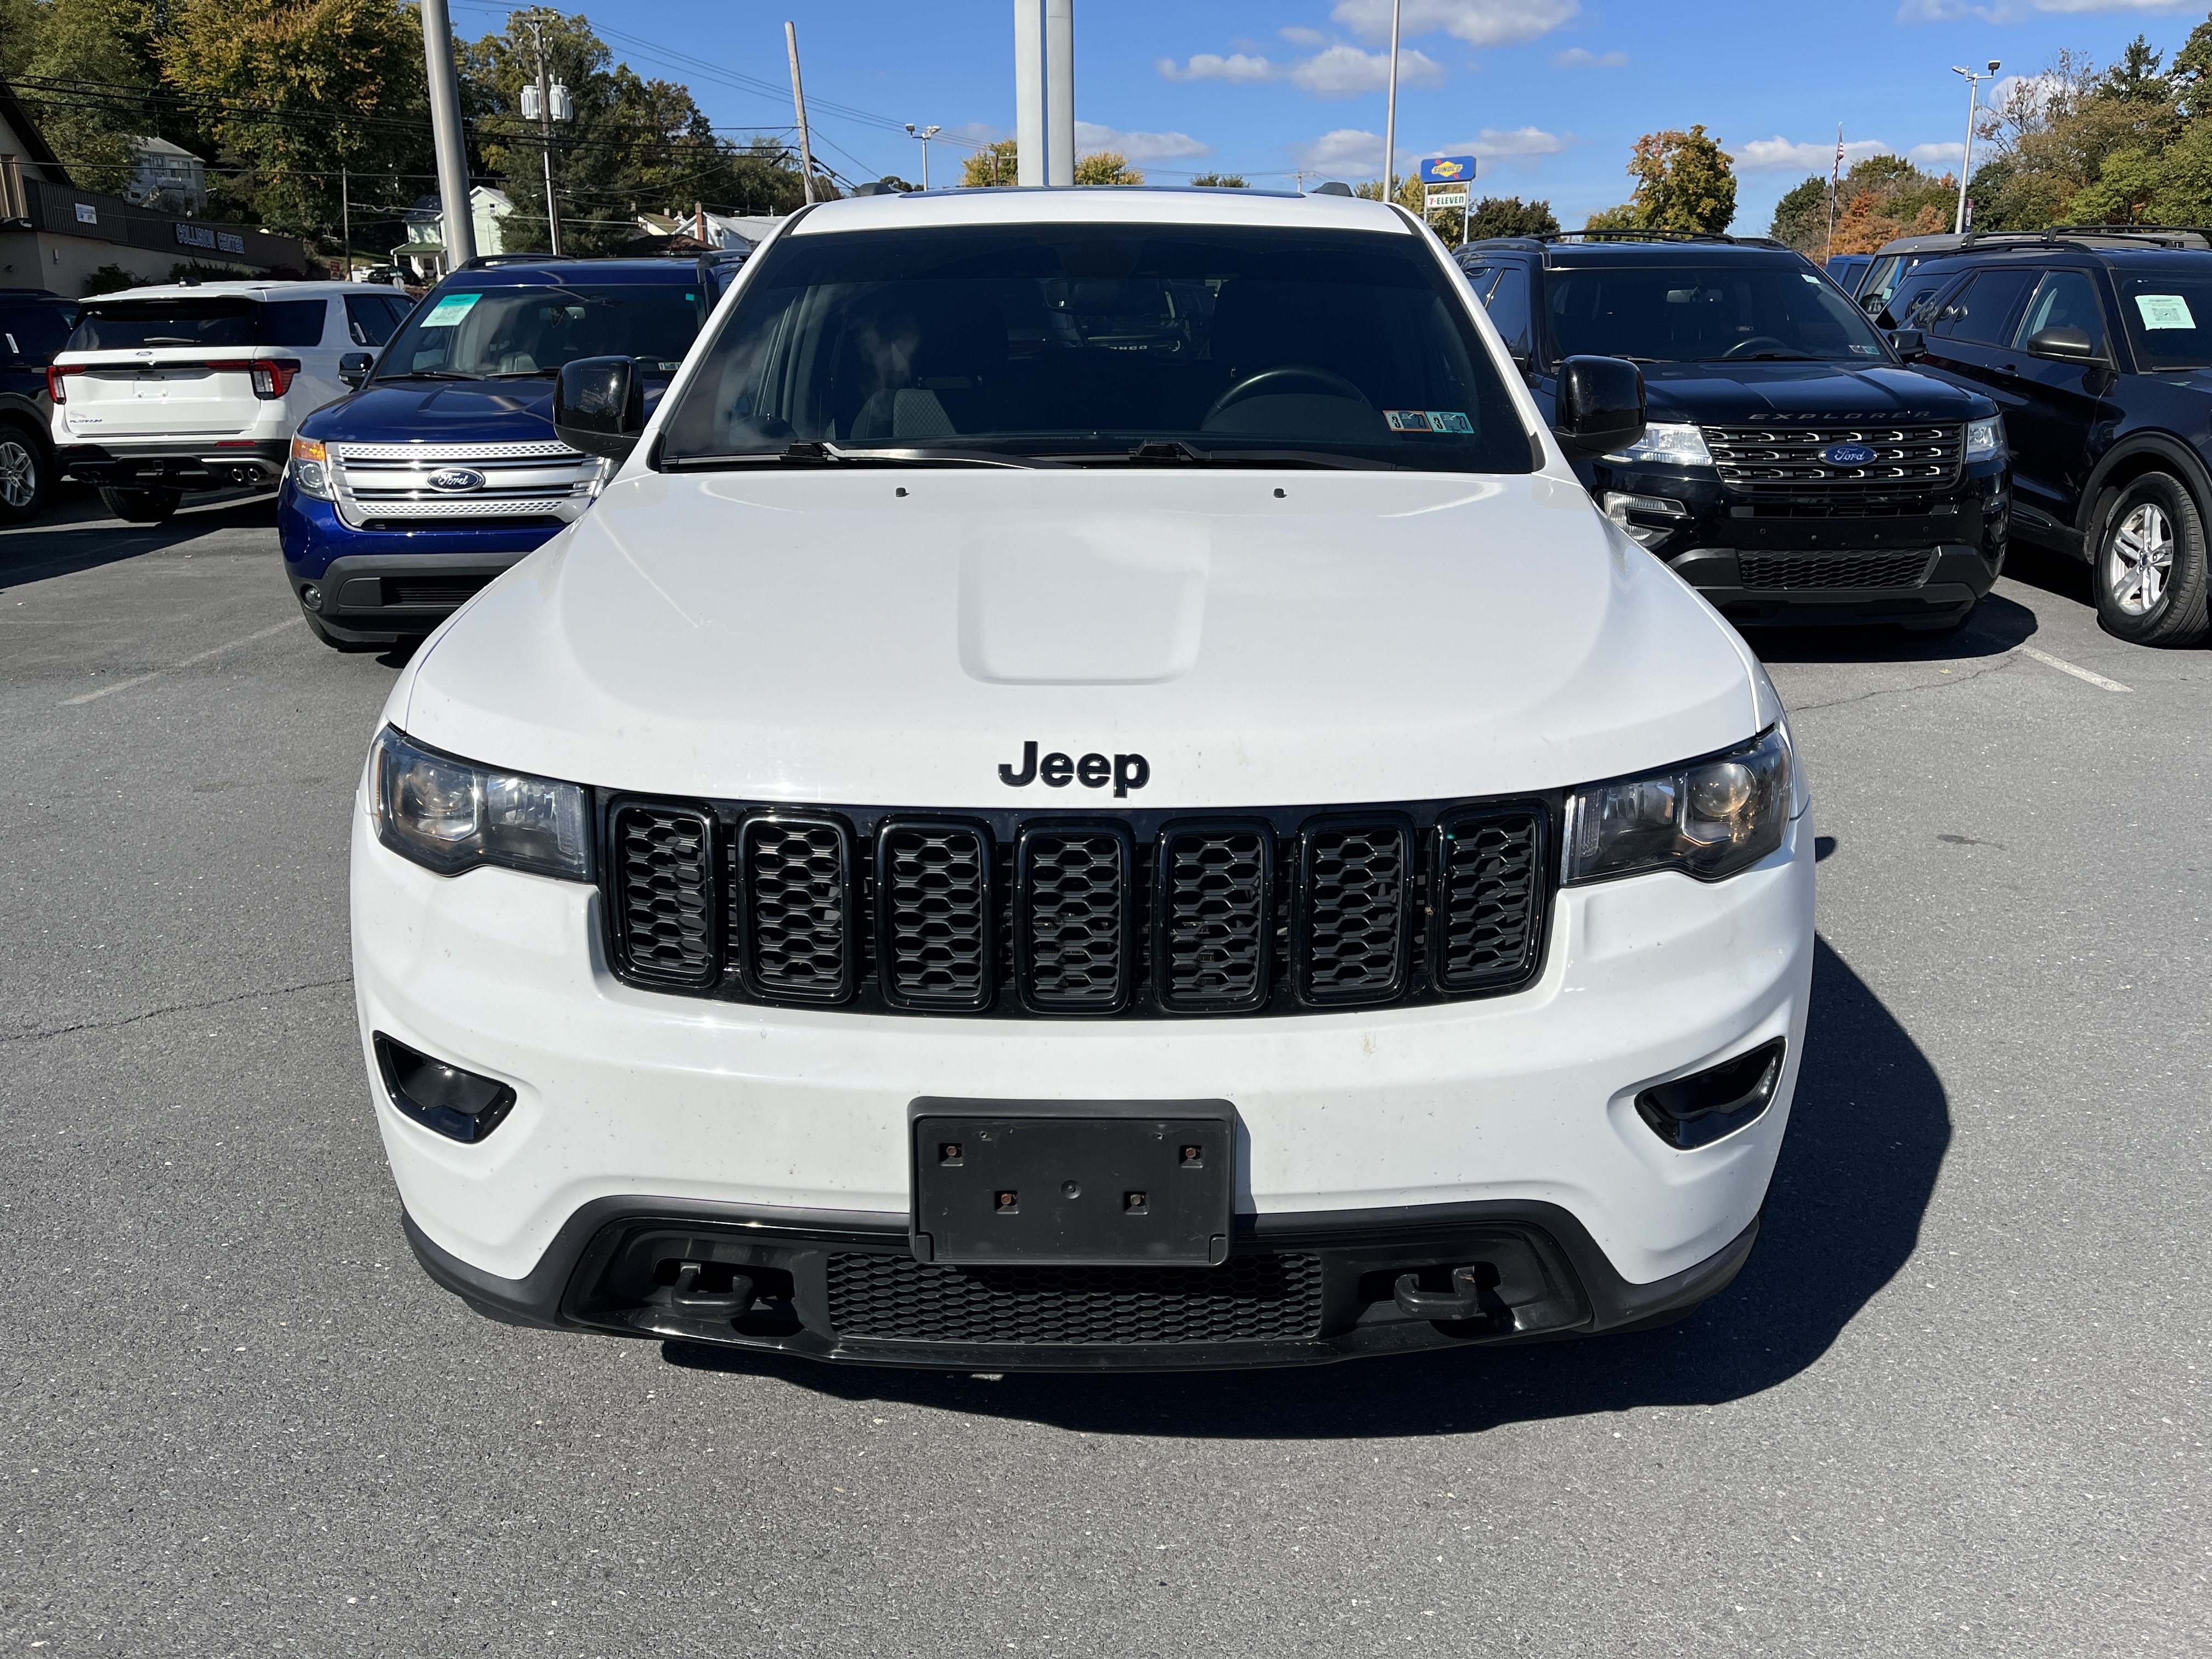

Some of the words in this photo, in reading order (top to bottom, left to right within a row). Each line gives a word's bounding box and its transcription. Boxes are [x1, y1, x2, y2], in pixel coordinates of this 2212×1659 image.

[176, 223, 216, 249] COLLISION
[217, 232, 245, 255] CENTER
[1392, 416, 1401, 428] 3
[1748, 411, 1931, 420] EXPLORER
[1434, 417, 1443, 430] 3
[1835, 448, 1865, 461] Ford
[438, 473, 469, 486] Ford
[998, 741, 1150, 798] Jeep
